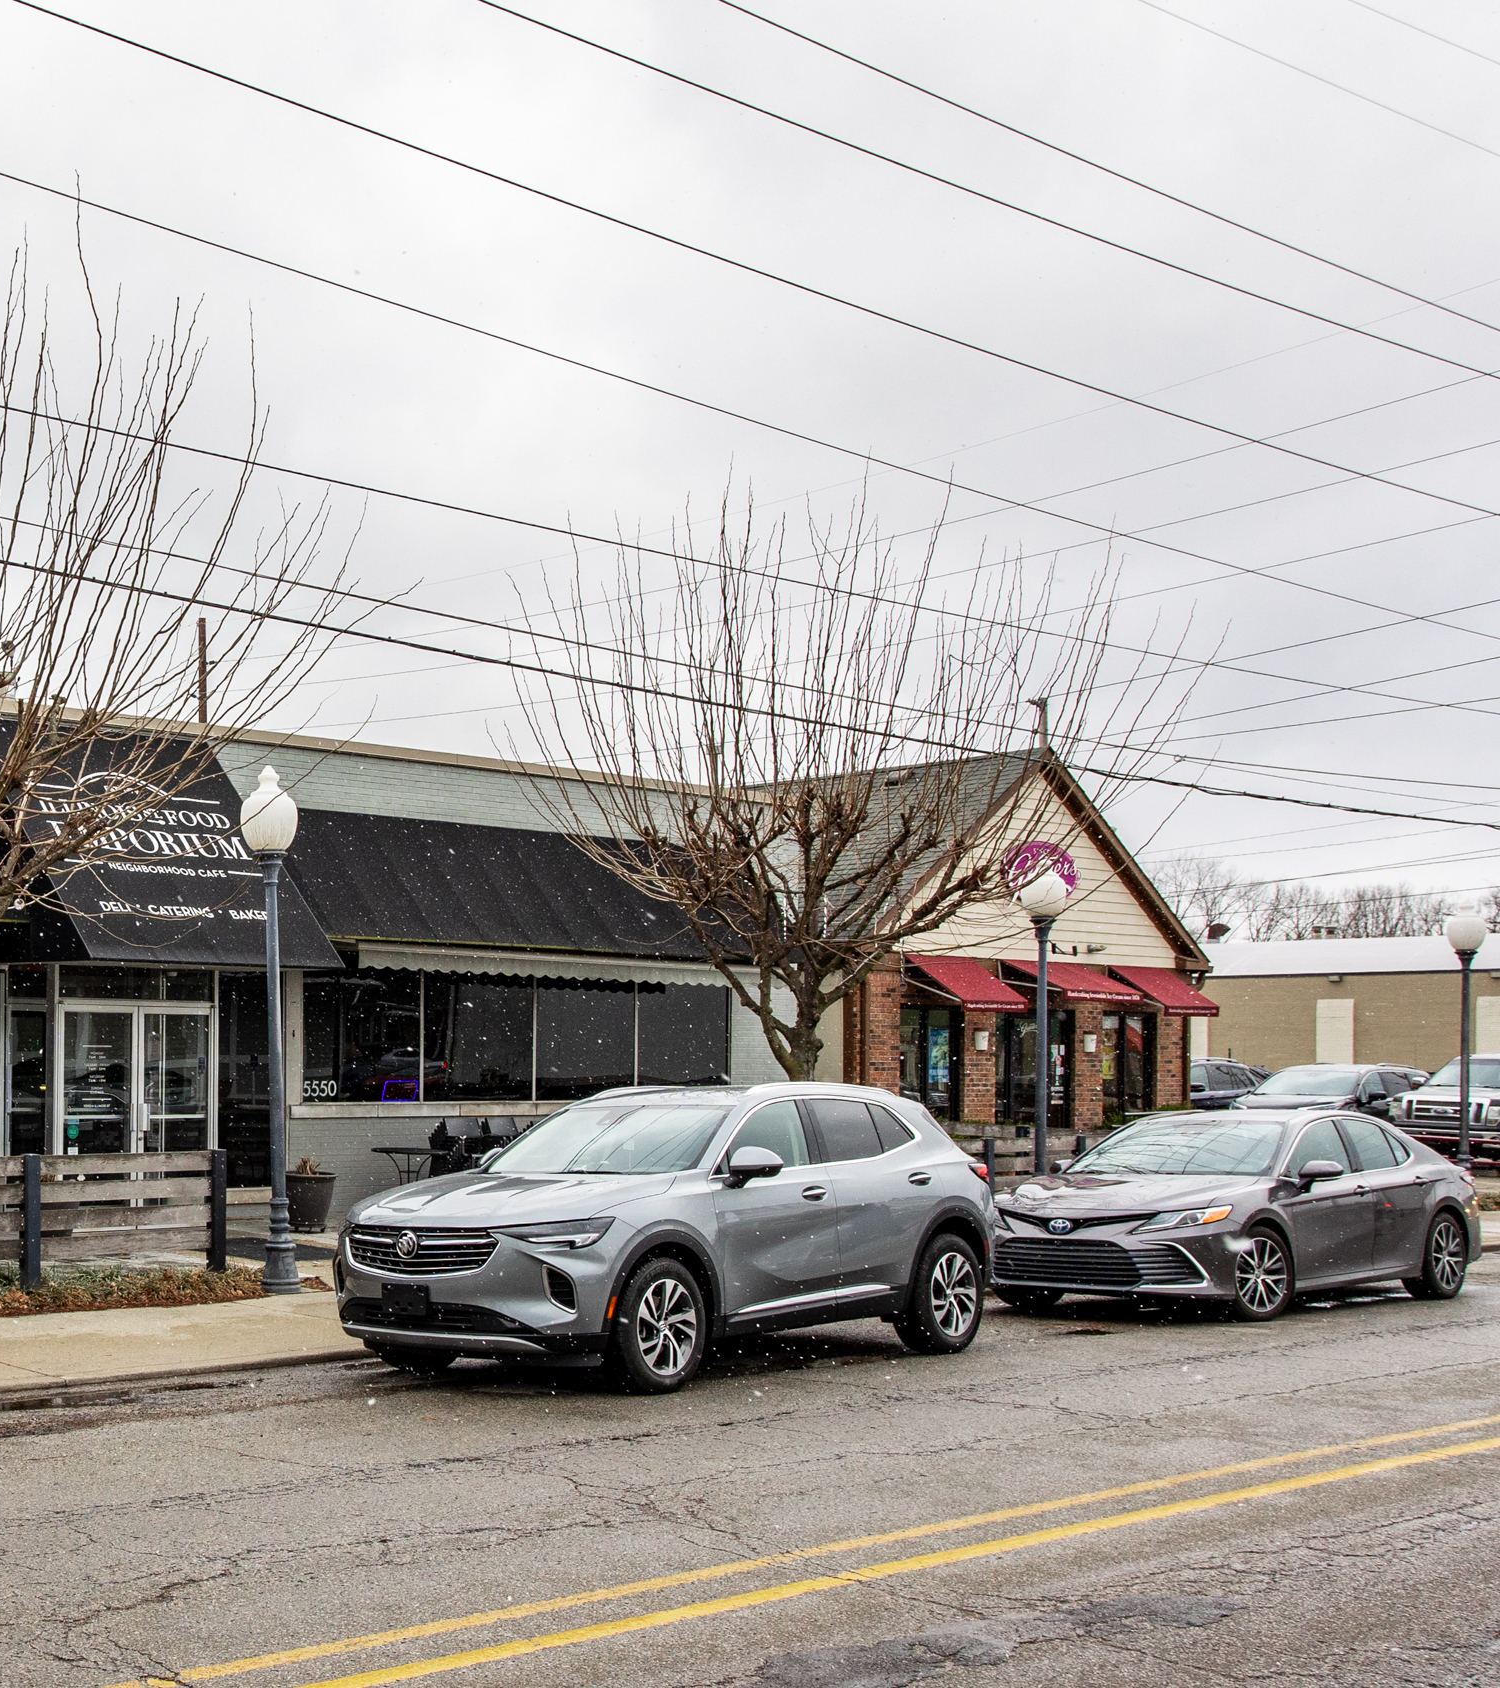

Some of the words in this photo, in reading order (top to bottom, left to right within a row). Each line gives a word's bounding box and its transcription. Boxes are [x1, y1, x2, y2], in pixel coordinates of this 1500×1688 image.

[161, 809, 231, 830] FOOD
[45, 820, 253, 861] PORIUM
[107, 862, 197, 877] NEIGHBORHOOD
[197, 868, 228, 879] CAFE
[99, 900, 132, 914] DELI
[147, 904, 215, 919] CATERING
[302, 1080, 337, 1097] 5550
